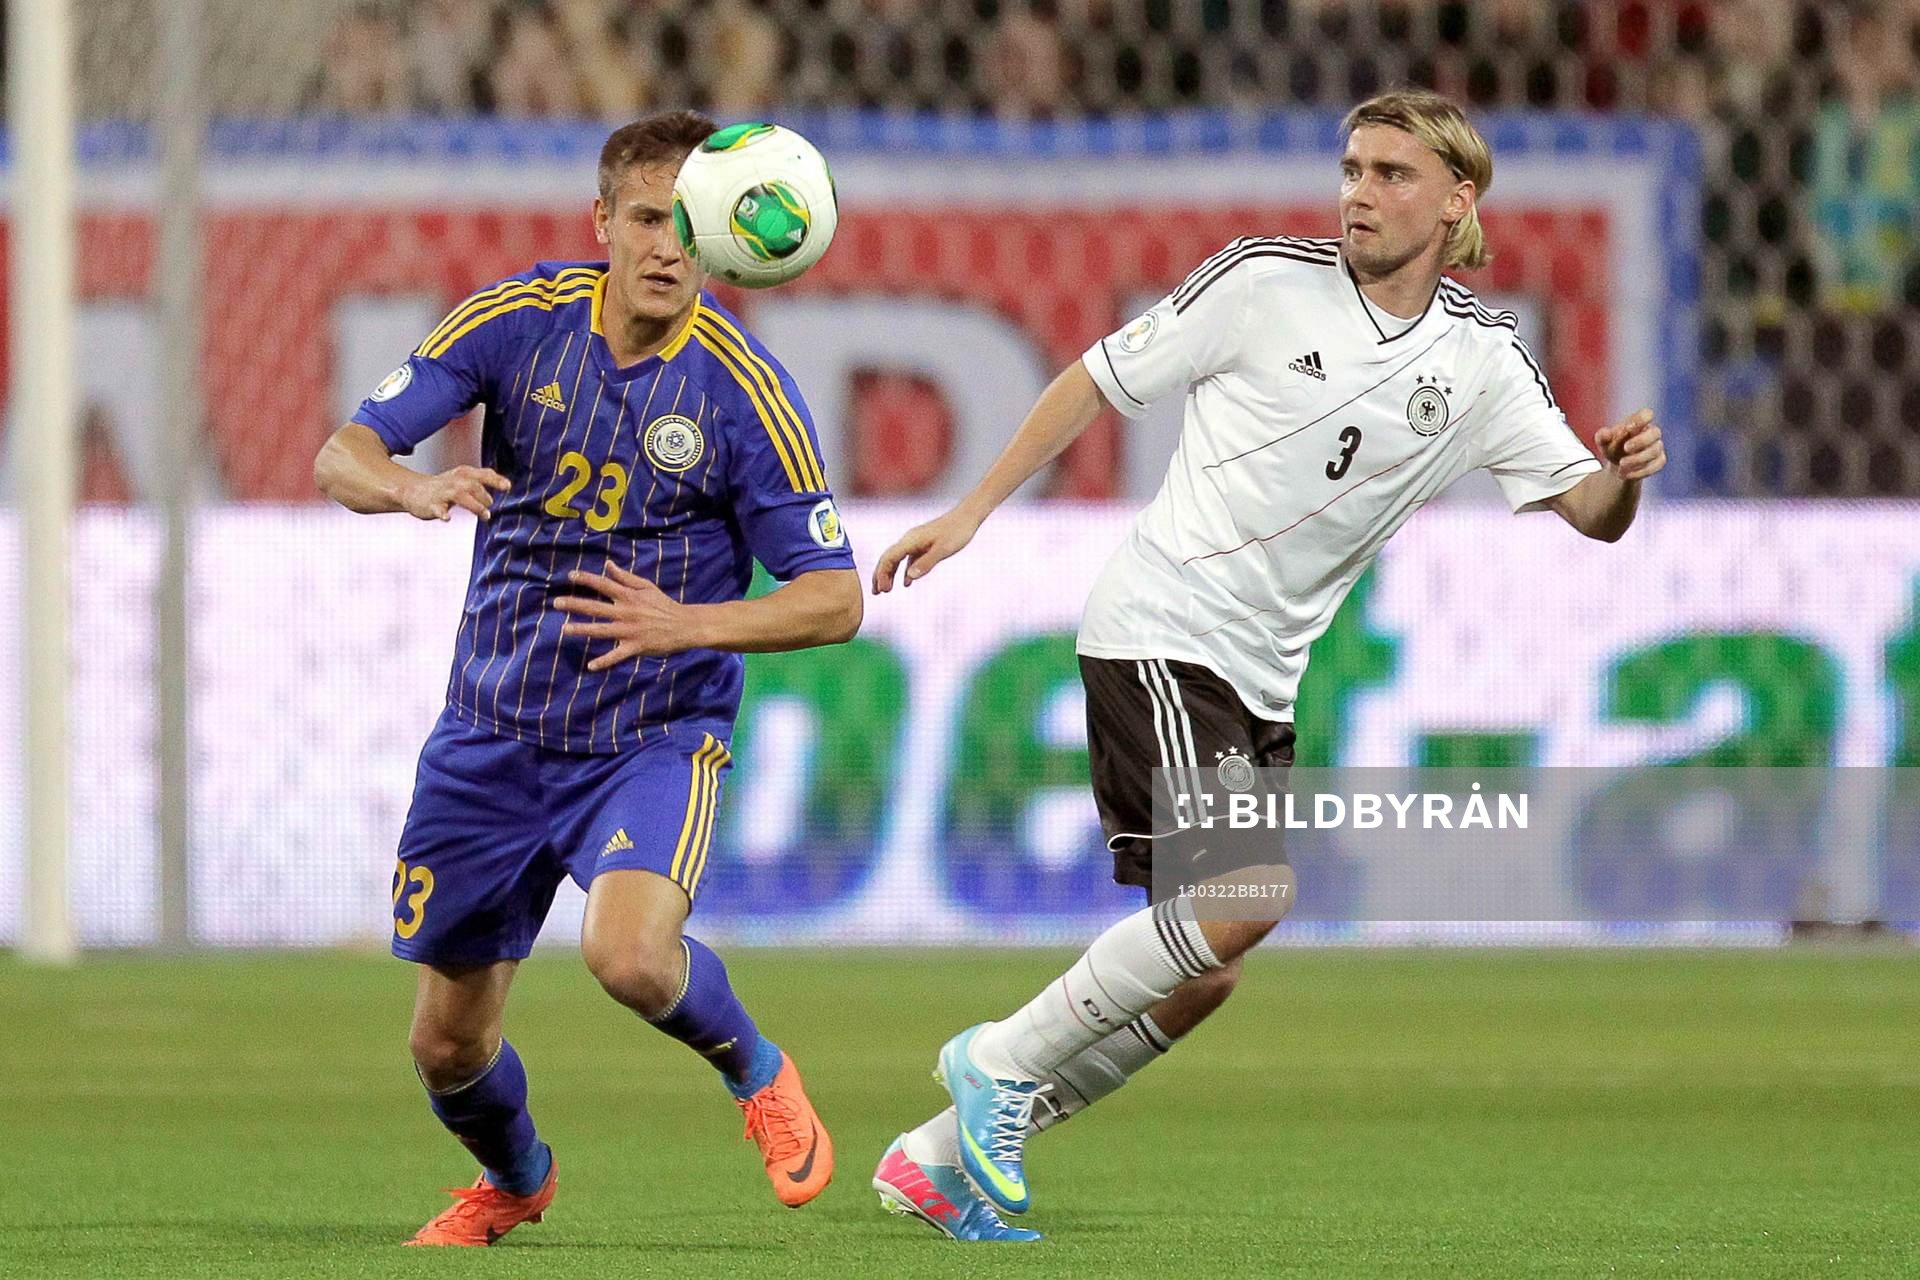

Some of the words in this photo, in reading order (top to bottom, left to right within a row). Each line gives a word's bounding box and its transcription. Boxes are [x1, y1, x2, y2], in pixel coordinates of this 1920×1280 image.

[1288, 362, 1326, 381] adidas
[1325, 425, 1362, 481] 3
[544, 451, 628, 532] 23
